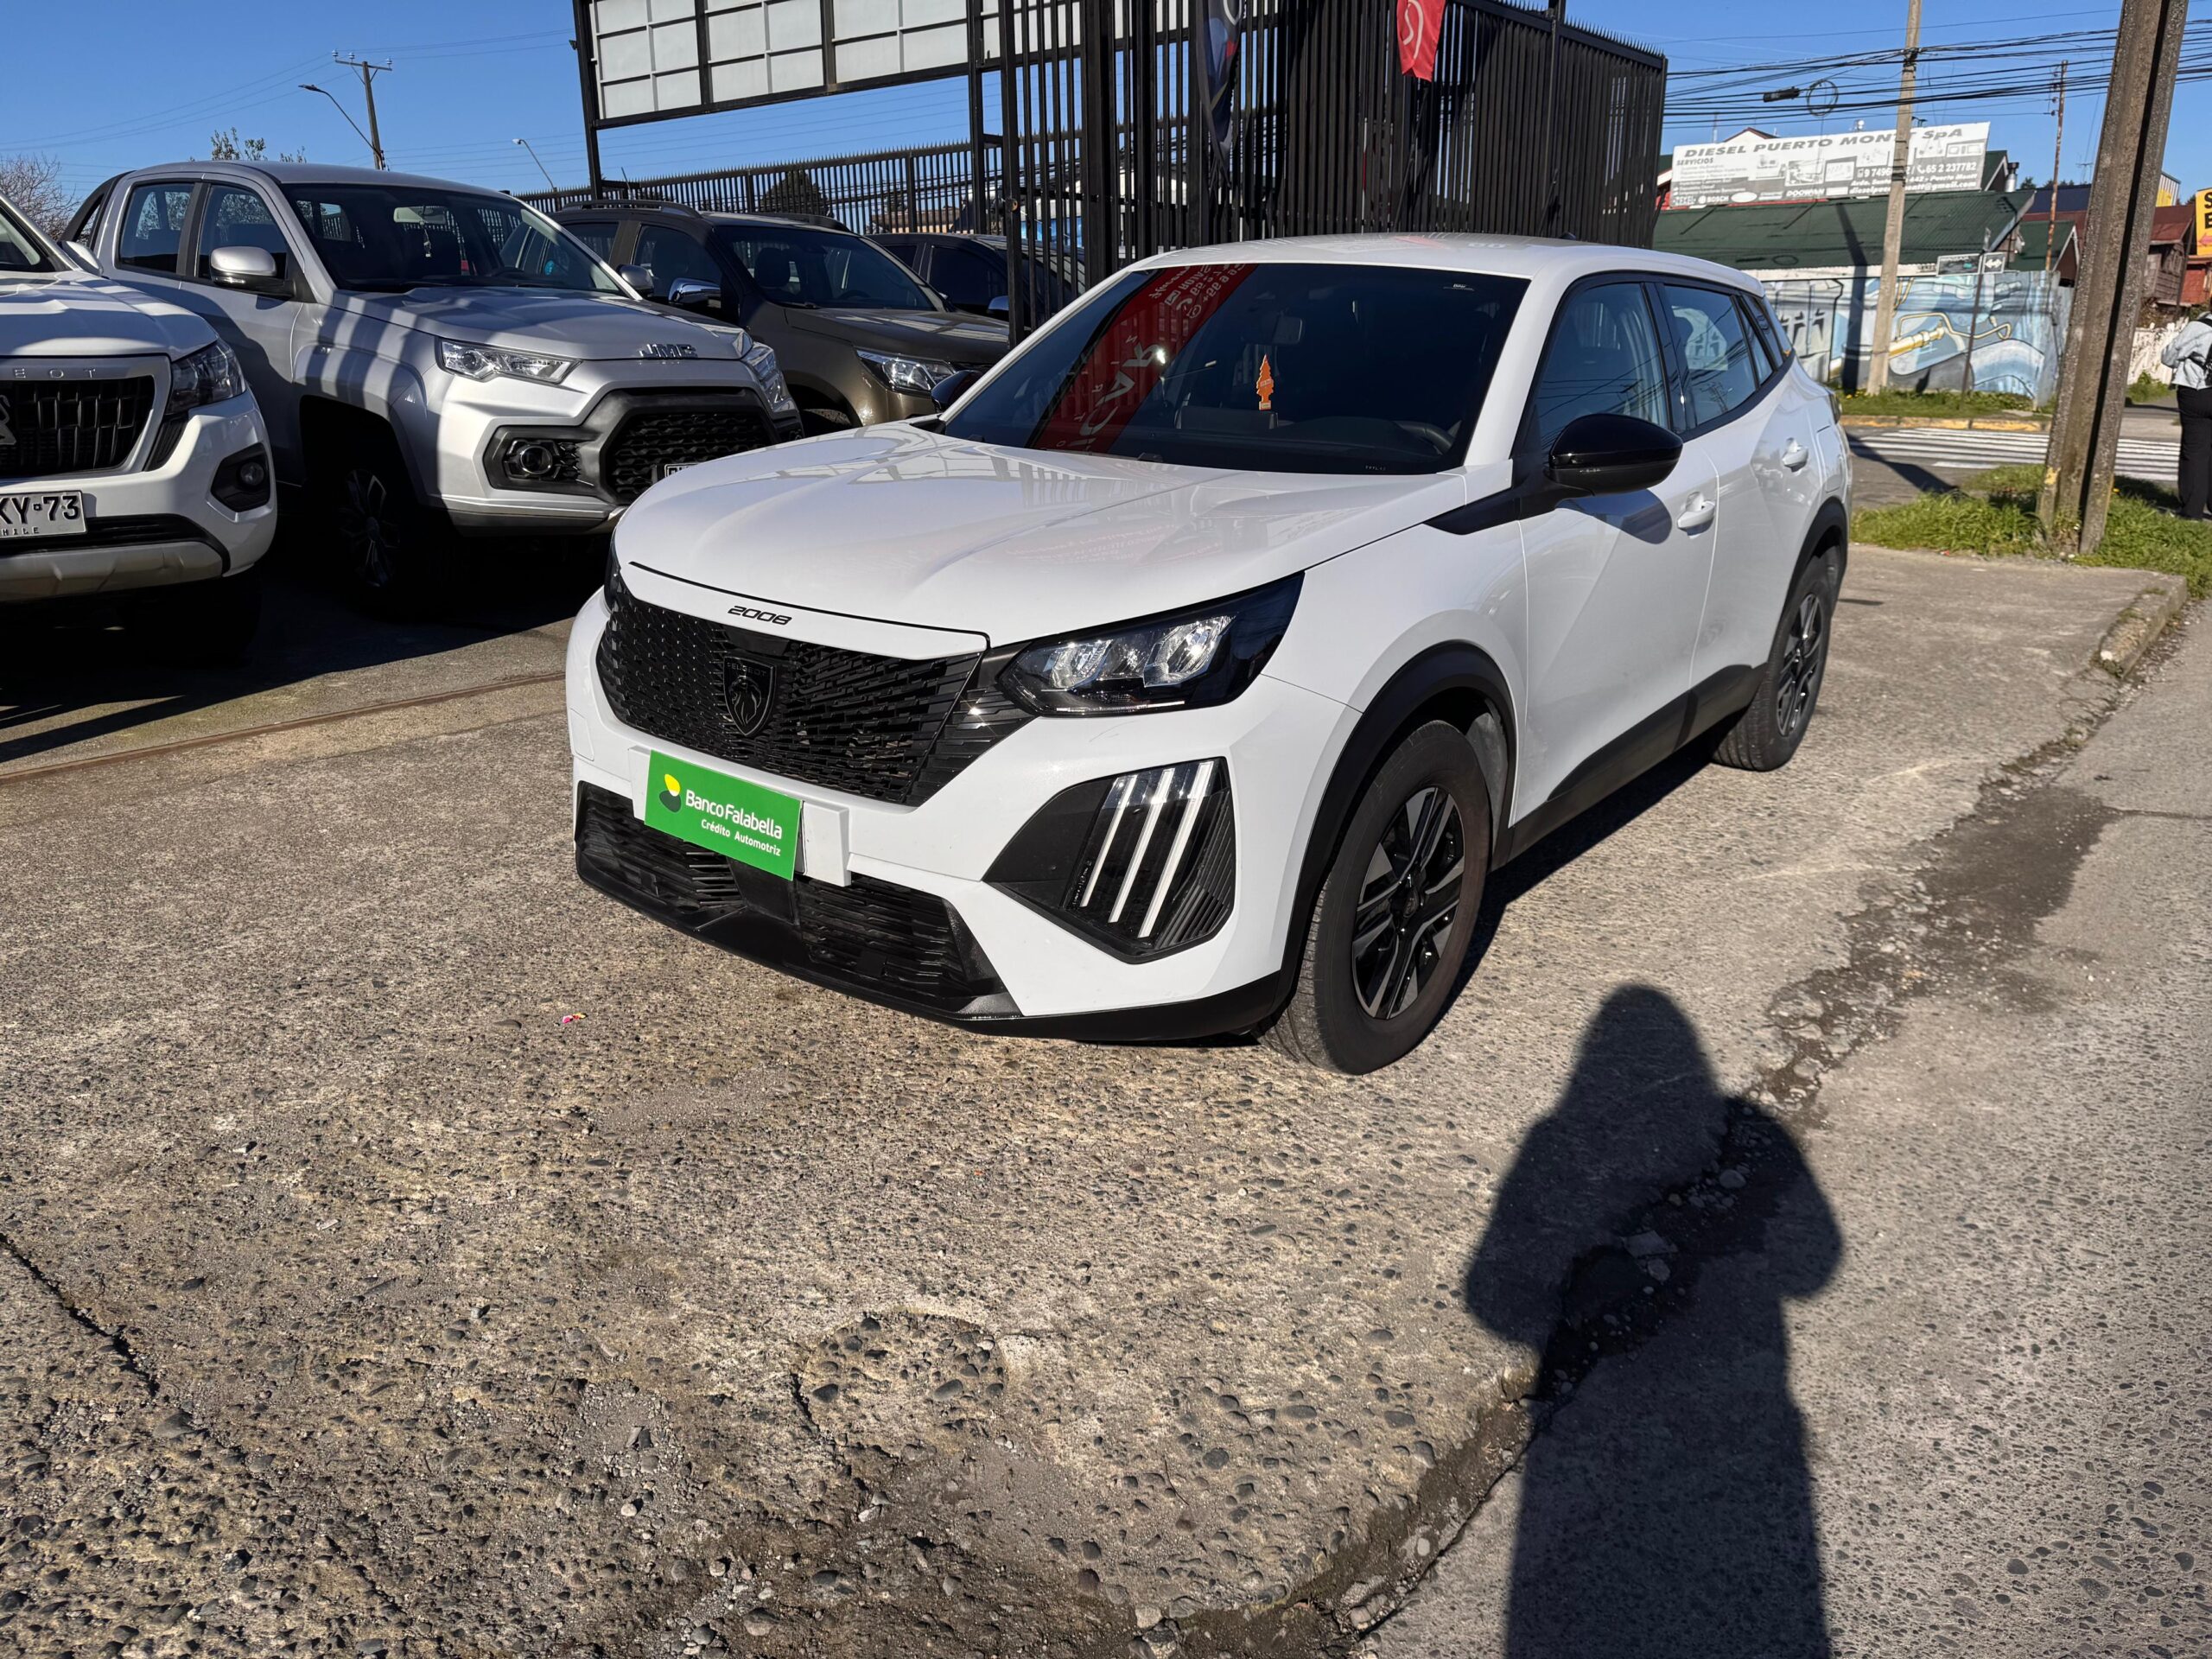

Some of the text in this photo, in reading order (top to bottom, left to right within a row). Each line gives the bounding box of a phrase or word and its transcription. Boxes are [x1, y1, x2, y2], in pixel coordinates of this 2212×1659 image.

[1684, 128, 1963, 158] DIESEL PUERTO MON SpA
[1676, 157, 1714, 166] SERVICIOS
[1925, 164, 1938, 174] 65
[1938, 163, 1946, 173] 2
[1946, 162, 1977, 173] 237782
[2, 526, 40, 537] HILE
[727, 605, 793, 626] 2008
[701, 818, 781, 857] Crédito Automotriz
